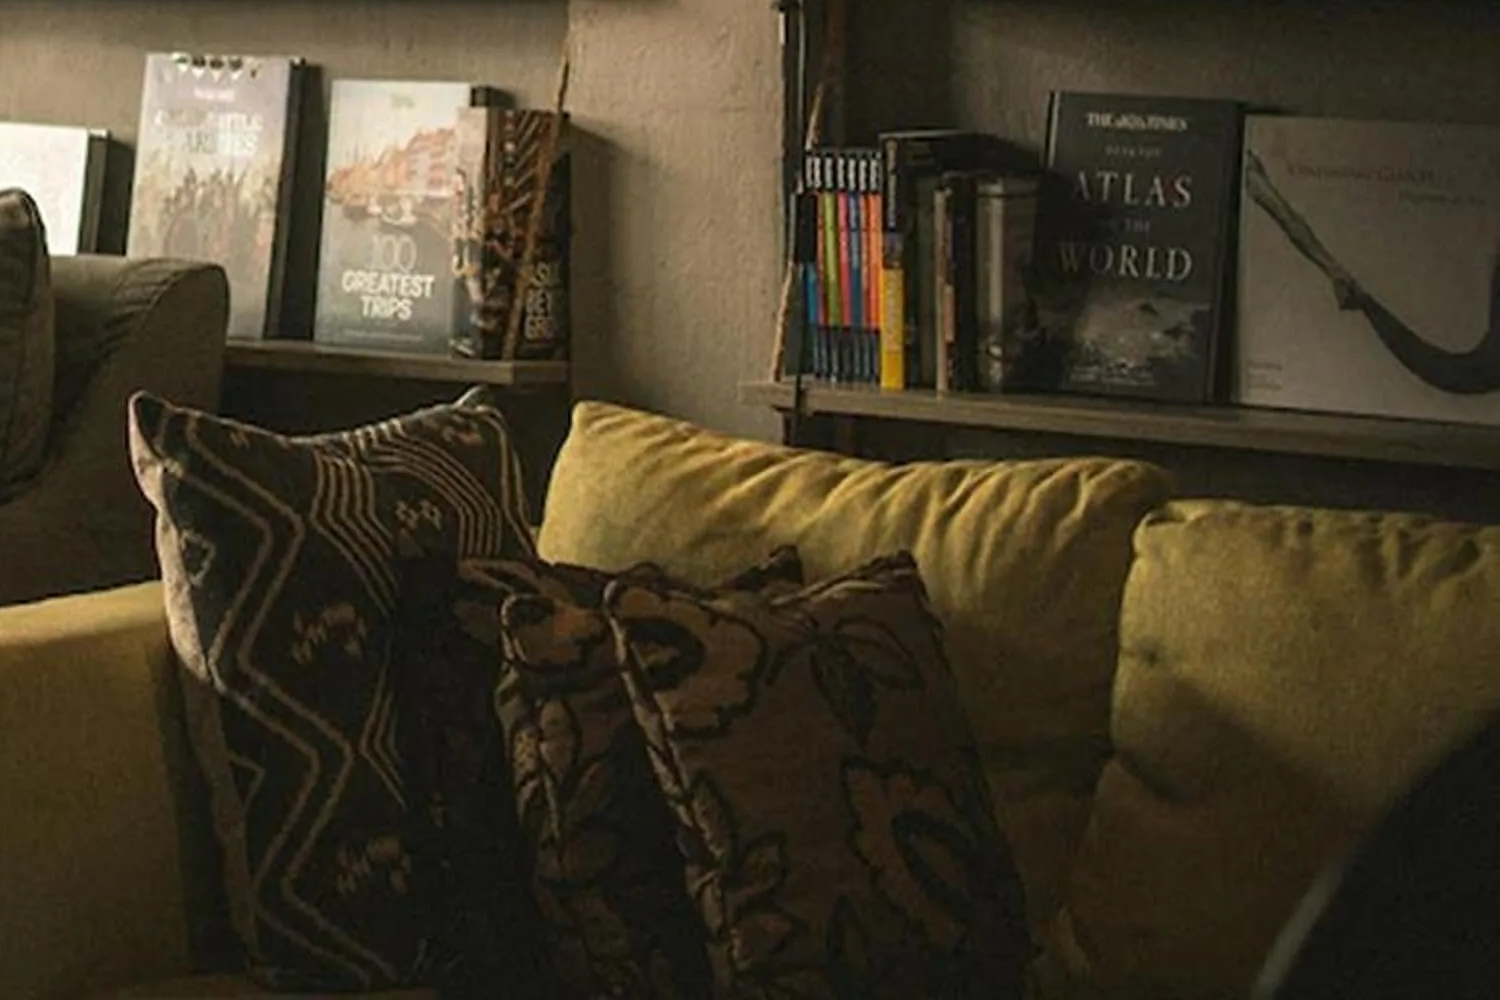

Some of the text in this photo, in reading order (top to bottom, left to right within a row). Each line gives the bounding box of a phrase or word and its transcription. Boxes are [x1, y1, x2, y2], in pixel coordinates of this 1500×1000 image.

[1072, 168, 1195, 208] ATLAS
[366, 234, 418, 274] 100
[1057, 243, 1195, 282] WORLD
[341, 268, 436, 299] GREATEST
[361, 296, 414, 322] TRIPS
